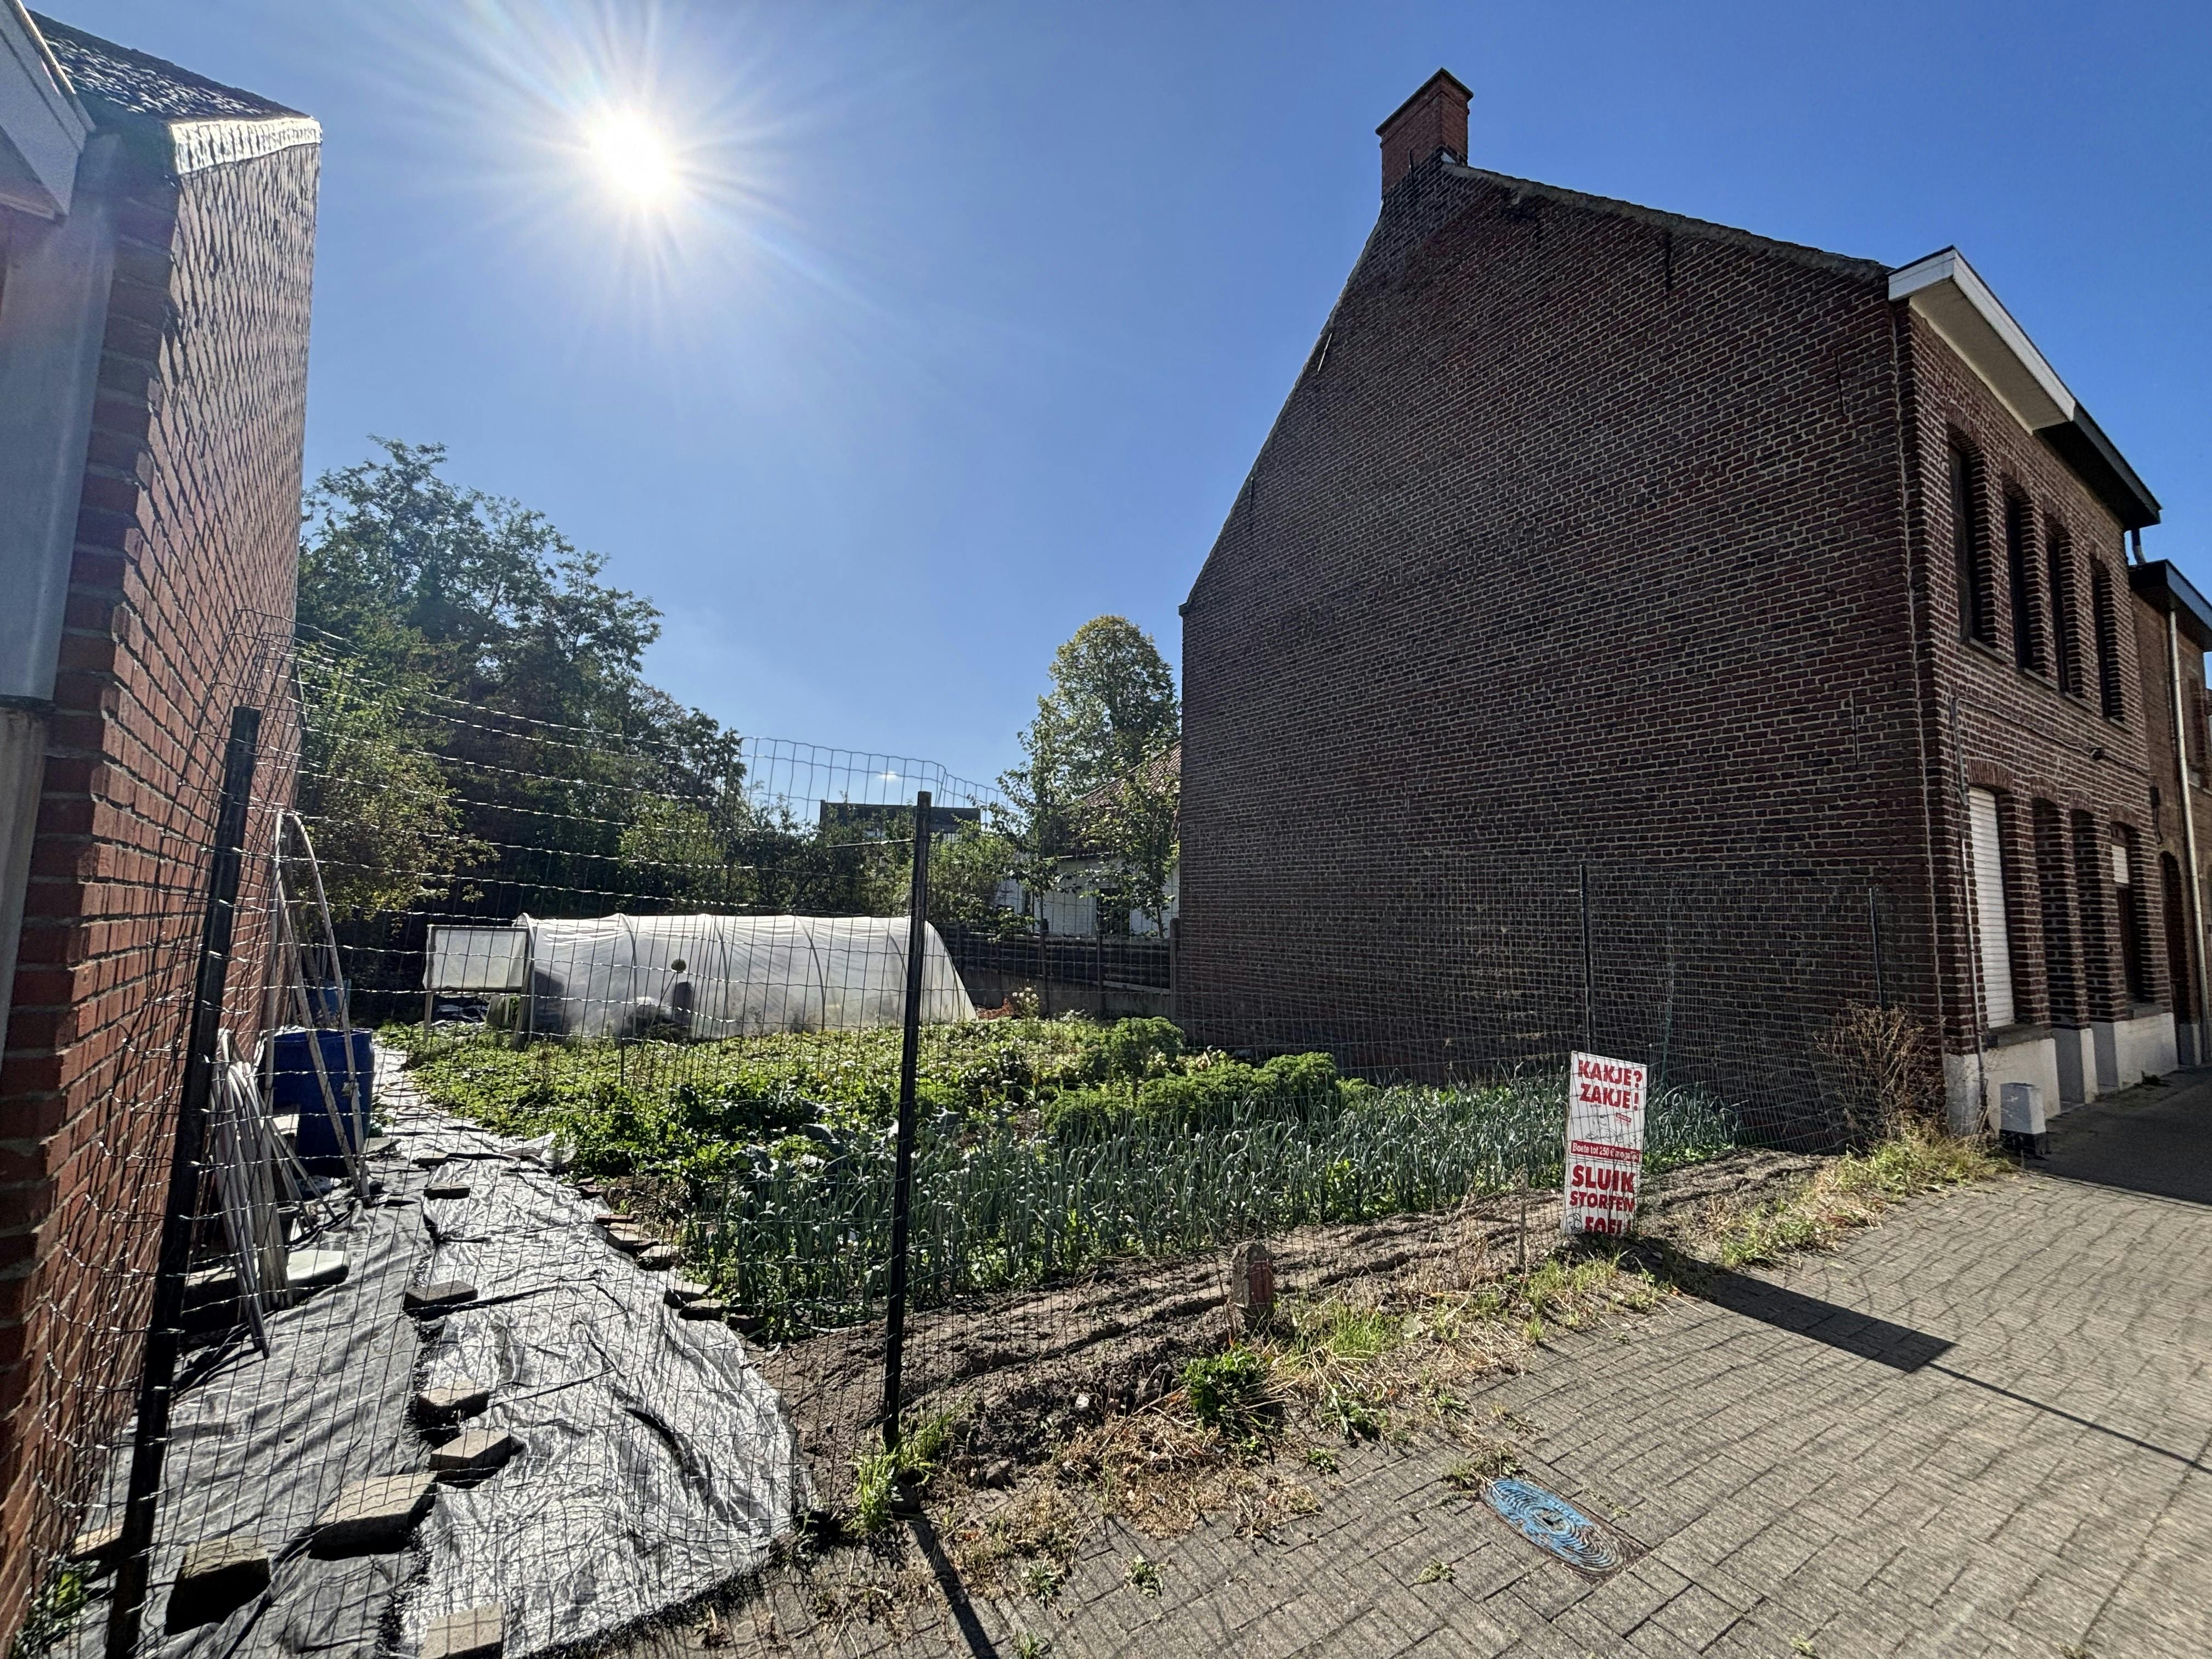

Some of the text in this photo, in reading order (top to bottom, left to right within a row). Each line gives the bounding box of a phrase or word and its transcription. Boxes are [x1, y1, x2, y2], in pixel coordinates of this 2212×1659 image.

[1578, 1060, 1642, 1088] KAKJE?
[1580, 1083, 1638, 1111] ZAKJE!
[1573, 1142, 1589, 1153] Boete
[1590, 1146, 1599, 1155] tot
[1600, 1147, 1610, 1156] 250
[1572, 1165, 1635, 1193] SLUIK
[1570, 1191, 1634, 1212] STORTEN
